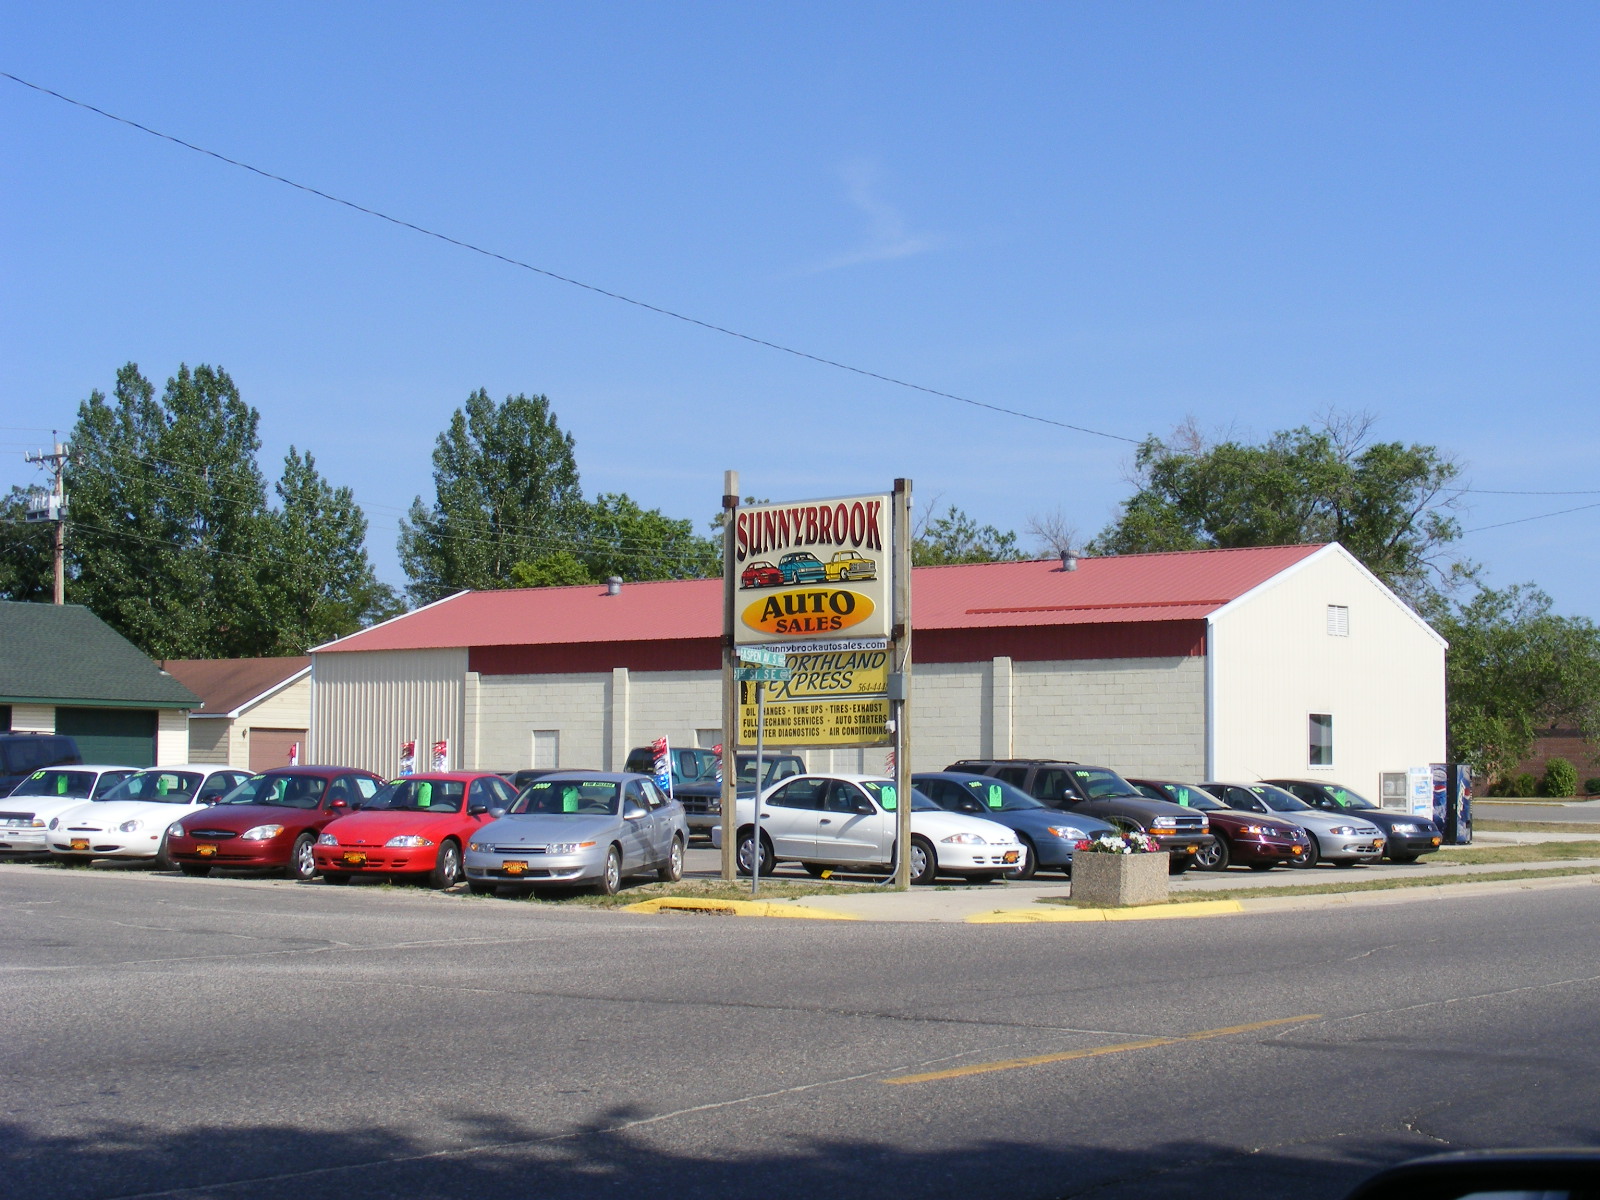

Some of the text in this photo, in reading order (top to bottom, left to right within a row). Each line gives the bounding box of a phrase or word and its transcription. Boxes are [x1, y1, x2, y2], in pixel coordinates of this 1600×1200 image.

[736, 500, 882, 562] SUNNYBROOK
[760, 590, 856, 623] AUTO
[775, 615, 843, 634] SALES
[750, 641, 886, 655] sunnybrookautosales.com
[774, 652, 887, 673] ORTHLAND
[745, 708, 756, 716] OIL
[793, 705, 809, 715] TUNE
[811, 704, 823, 714] UPS
[743, 718, 758, 727] FULL
[793, 716, 824, 726] SERVICES
[835, 715, 852, 725] AUTO
[854, 714, 887, 724] STARTERS
[778, 727, 820, 738] DIAGNOSTICS
[829, 726, 840, 736] AIR
